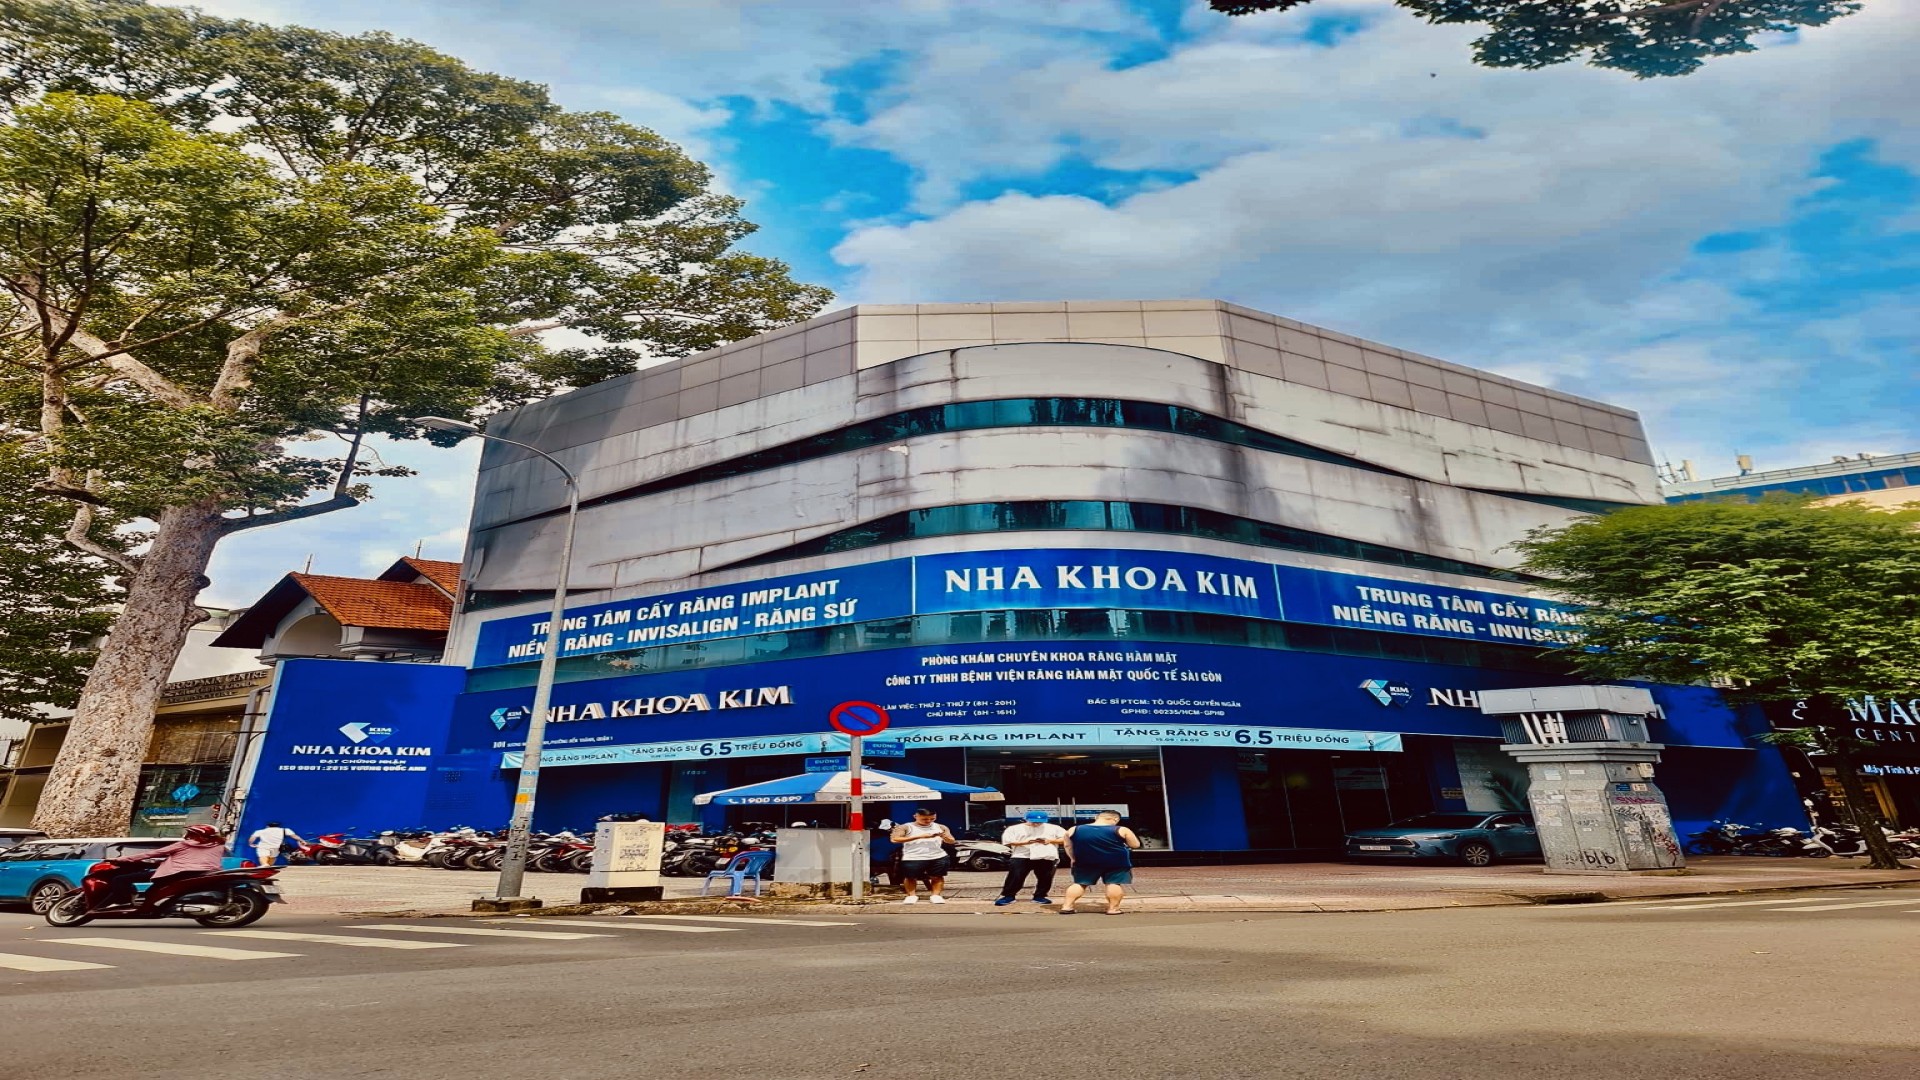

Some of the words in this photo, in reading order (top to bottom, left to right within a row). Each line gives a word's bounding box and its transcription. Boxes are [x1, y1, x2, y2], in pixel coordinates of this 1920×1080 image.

[945, 566, 1041, 592] NHA
[1056, 565, 1187, 592] KHOA
[1196, 571, 1258, 598] KIM
[532, 616, 587, 635] TRNG
[593, 610, 631, 627] TÂM
[637, 600, 674, 621] CẤY
[680, 595, 734, 615] RĂNG
[741, 579, 839, 607] IMPLANT
[1356, 586, 1433, 608] TRUNG
[1438, 595, 1485, 615] TÂM
[1491, 600, 1529, 620] CẤY
[508, 639, 548, 658] NIỀN
[564, 633, 613, 651] RĂNG
[628, 616, 739, 643] INVISALIGN
[755, 607, 815, 628] RĂNG
[824, 598, 858, 619] SỨ
[1333, 605, 1407, 627] NIỀNG
[1413, 613, 1475, 635] RĂNG
[922, 654, 958, 667] PHÒNG
[960, 652, 995, 664] KHÁM
[997, 650, 1048, 663] CHUYÊN
[1050, 652, 1085, 662] KHOA
[1088, 651, 1123, 662] RĂNG
[1126, 650, 1153, 662] HÀM
[1155, 653, 1177, 664] MẶT
[885, 675, 911, 687] CÔNG
[913, 675, 927, 685] TY
[930, 673, 958, 683] TNHH
[960, 670, 992, 683] BỆNH
[996, 669, 1024, 682] VIỆN
[1027, 669, 1063, 680] RĂNG
[1066, 668, 1095, 680] HÀM
[1098, 669, 1123, 682] MẶT
[1126, 668, 1160, 681] QUỐC
[1163, 668, 1178, 681] TẾ
[1181, 670, 1199, 682] SÀI
[1201, 670, 1222, 682] GÒN
[611, 694, 710, 717] KHOA
[719, 686, 791, 709] KIM
[949, 732, 997, 742] RĂNG
[1004, 731, 1087, 741] IMPLANT
[1114, 728, 1160, 738] TẶNG
[1165, 728, 1209, 737] RĂNG
[1276, 734, 1312, 744] TRIỆU
[292, 746, 335, 755] NHA
[338, 746, 393, 755] KHOA
[396, 747, 431, 756] KIM
[735, 743, 766, 752] TRIỆU
[581, 753, 618, 761] IMPLANT
[741, 796, 770, 804] 1900
